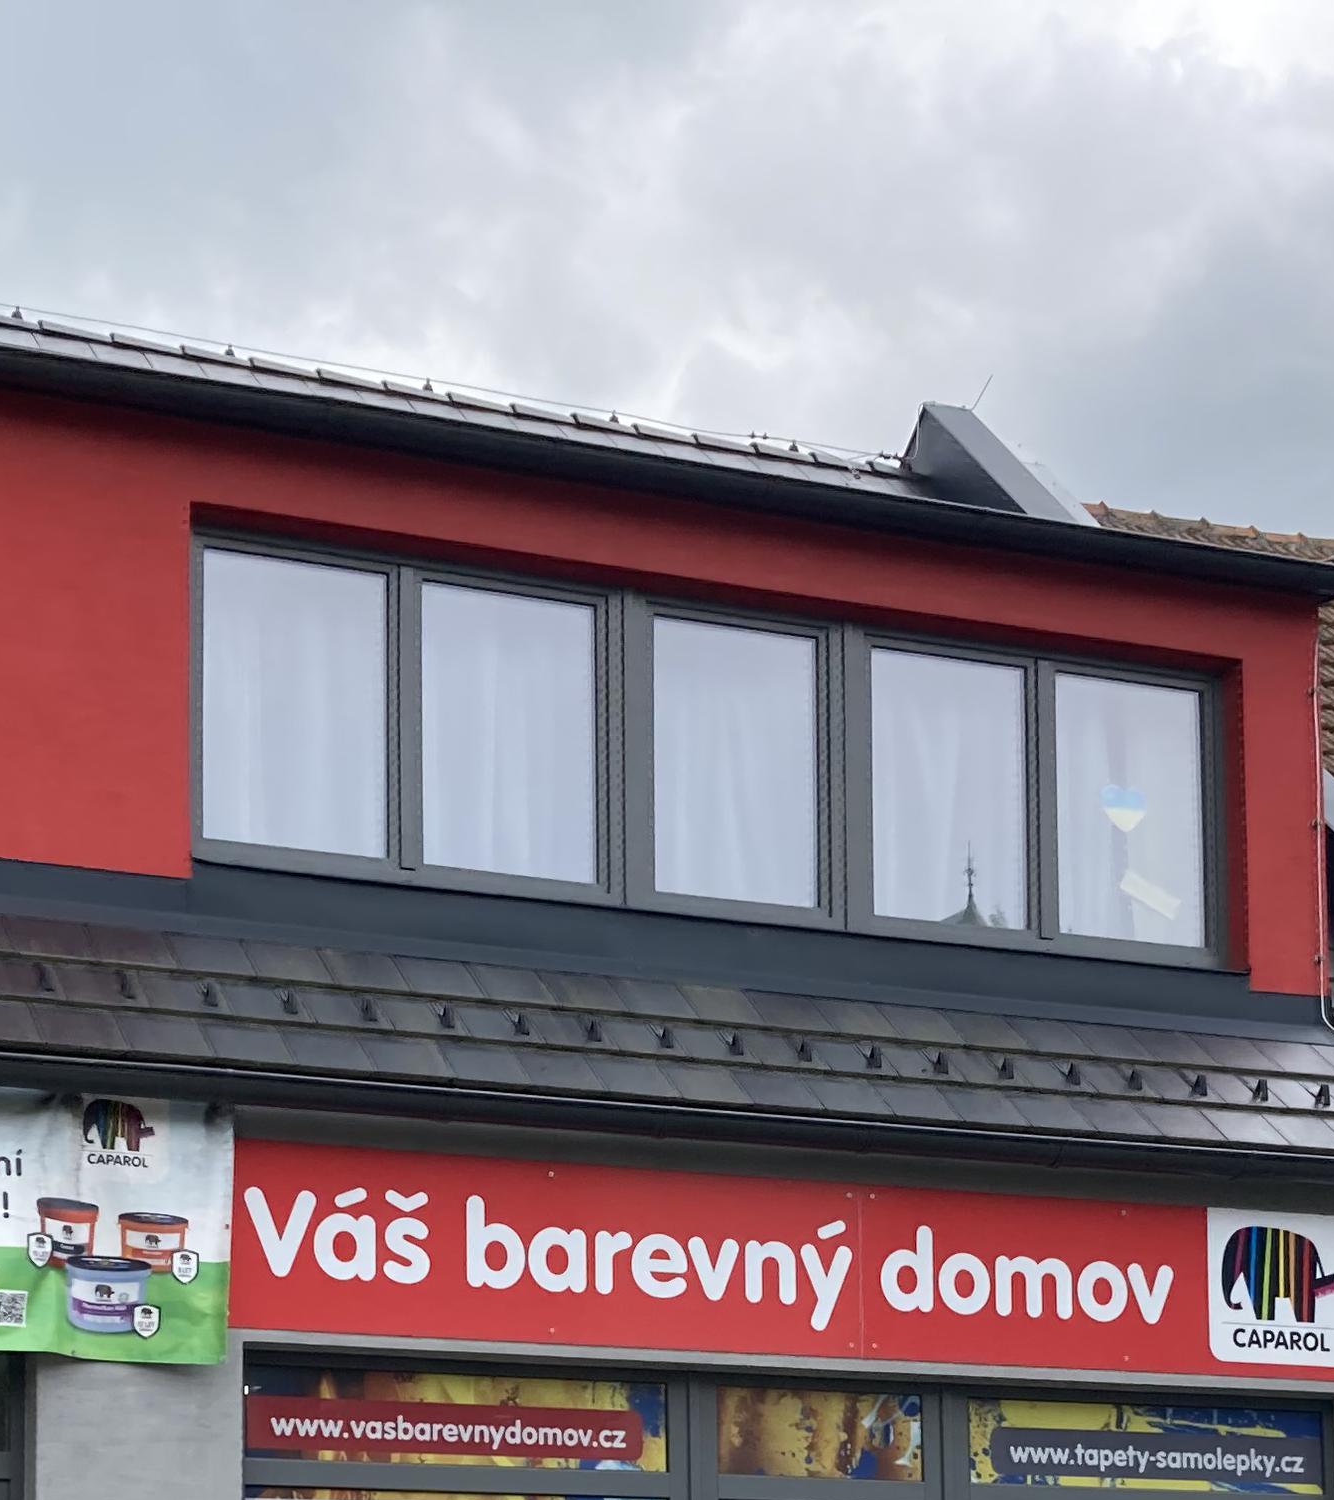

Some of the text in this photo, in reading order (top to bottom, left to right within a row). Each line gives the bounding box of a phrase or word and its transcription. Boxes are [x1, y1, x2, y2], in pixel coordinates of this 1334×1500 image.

[86, 1153, 150, 1170] CAPAROL
[243, 1185, 1175, 1332] Váš barevný domov
[1232, 1327, 1331, 1353] CAPAROL
[270, 1413, 627, 1450] www.vasbarevnydomov.cz
[1010, 1443, 1305, 1477] www.tapety-samolepky.cz
